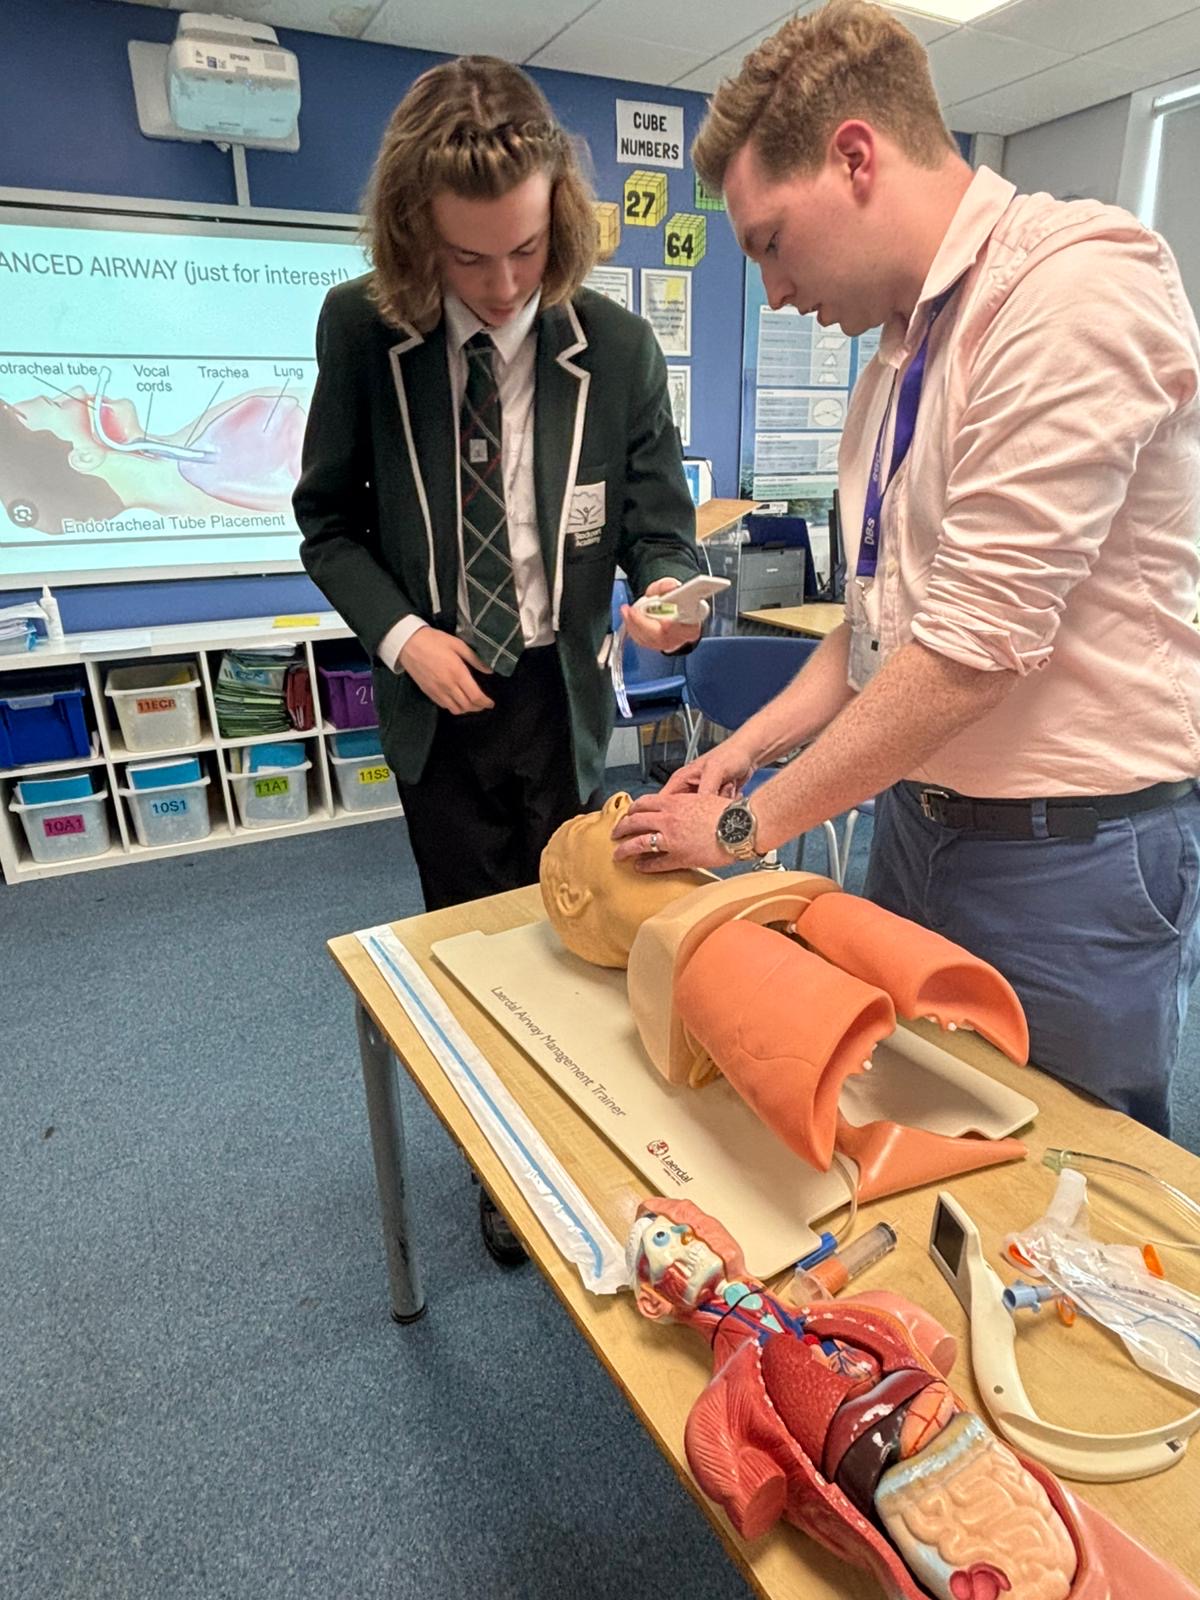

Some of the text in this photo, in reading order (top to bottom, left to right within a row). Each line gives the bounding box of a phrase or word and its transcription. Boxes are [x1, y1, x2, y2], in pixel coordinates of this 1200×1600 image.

[633, 111, 667, 132] CUBE
[621, 138, 680, 160] NUMBERS
[626, 190, 656, 219] 27
[667, 232, 694, 260] 64
[90, 256, 178, 280] AIRWAY
[184, 260, 230, 286] (just
[232, 263, 260, 284] for
[67, 363, 98, 376] tube
[133, 364, 170, 377] Vocal
[197, 366, 249, 378] Trachea
[274, 365, 304, 380] Lung
[136, 380, 172, 393] cords
[63, 514, 286, 534] Endotracheal Tube Placement
[864, 517, 875, 545] DBS
[360, 768, 390, 781] 11S3
[256, 779, 289, 795] 11A1
[152, 799, 188, 814] 10S1
[46, 816, 84, 833] 10A1
[491, 986, 626, 1117] Laerdal Airway Management Trainer
[662, 1155, 693, 1182] Laerdal
